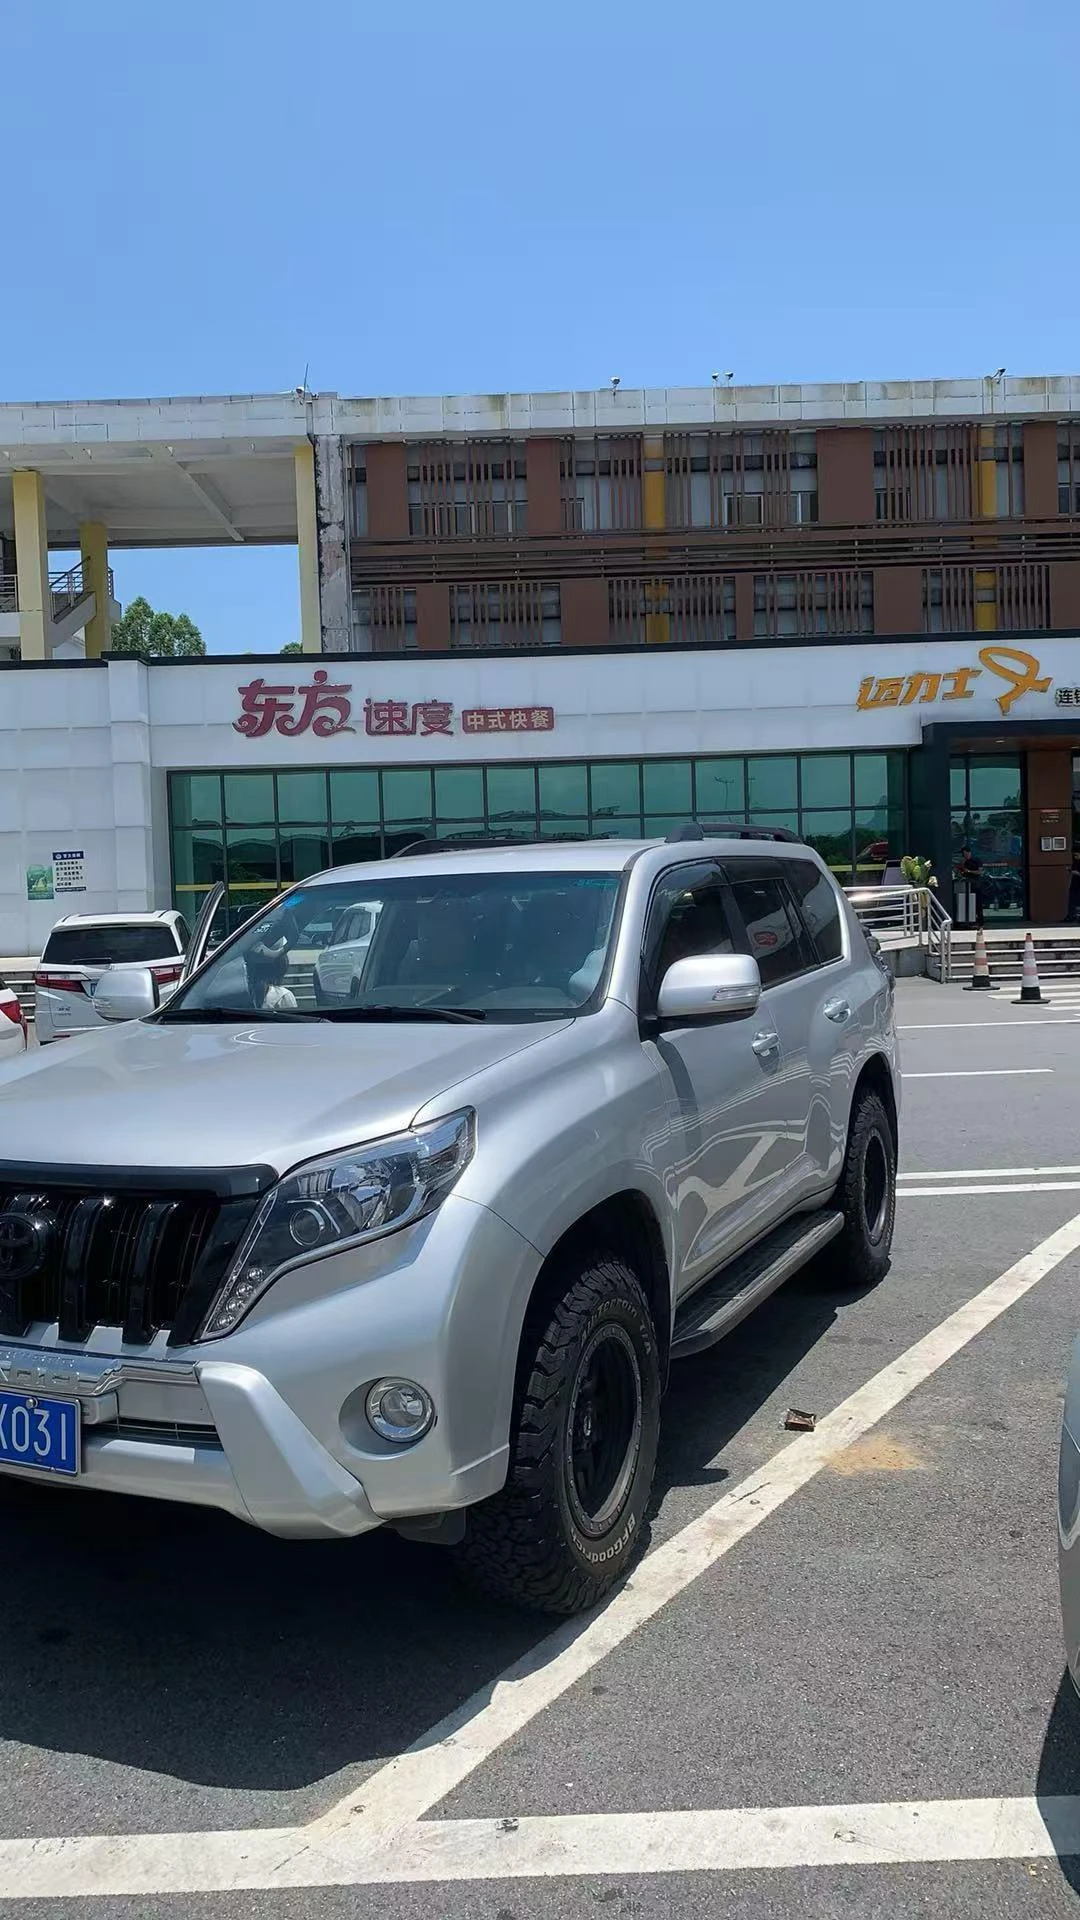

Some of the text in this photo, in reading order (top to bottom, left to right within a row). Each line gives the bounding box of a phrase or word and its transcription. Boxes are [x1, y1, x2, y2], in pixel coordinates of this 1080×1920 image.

[856, 667, 983, 711] 迈力士
[467, 709, 549, 730] 中式快餐
[571, 1513, 636, 1564] BFGoodrich
